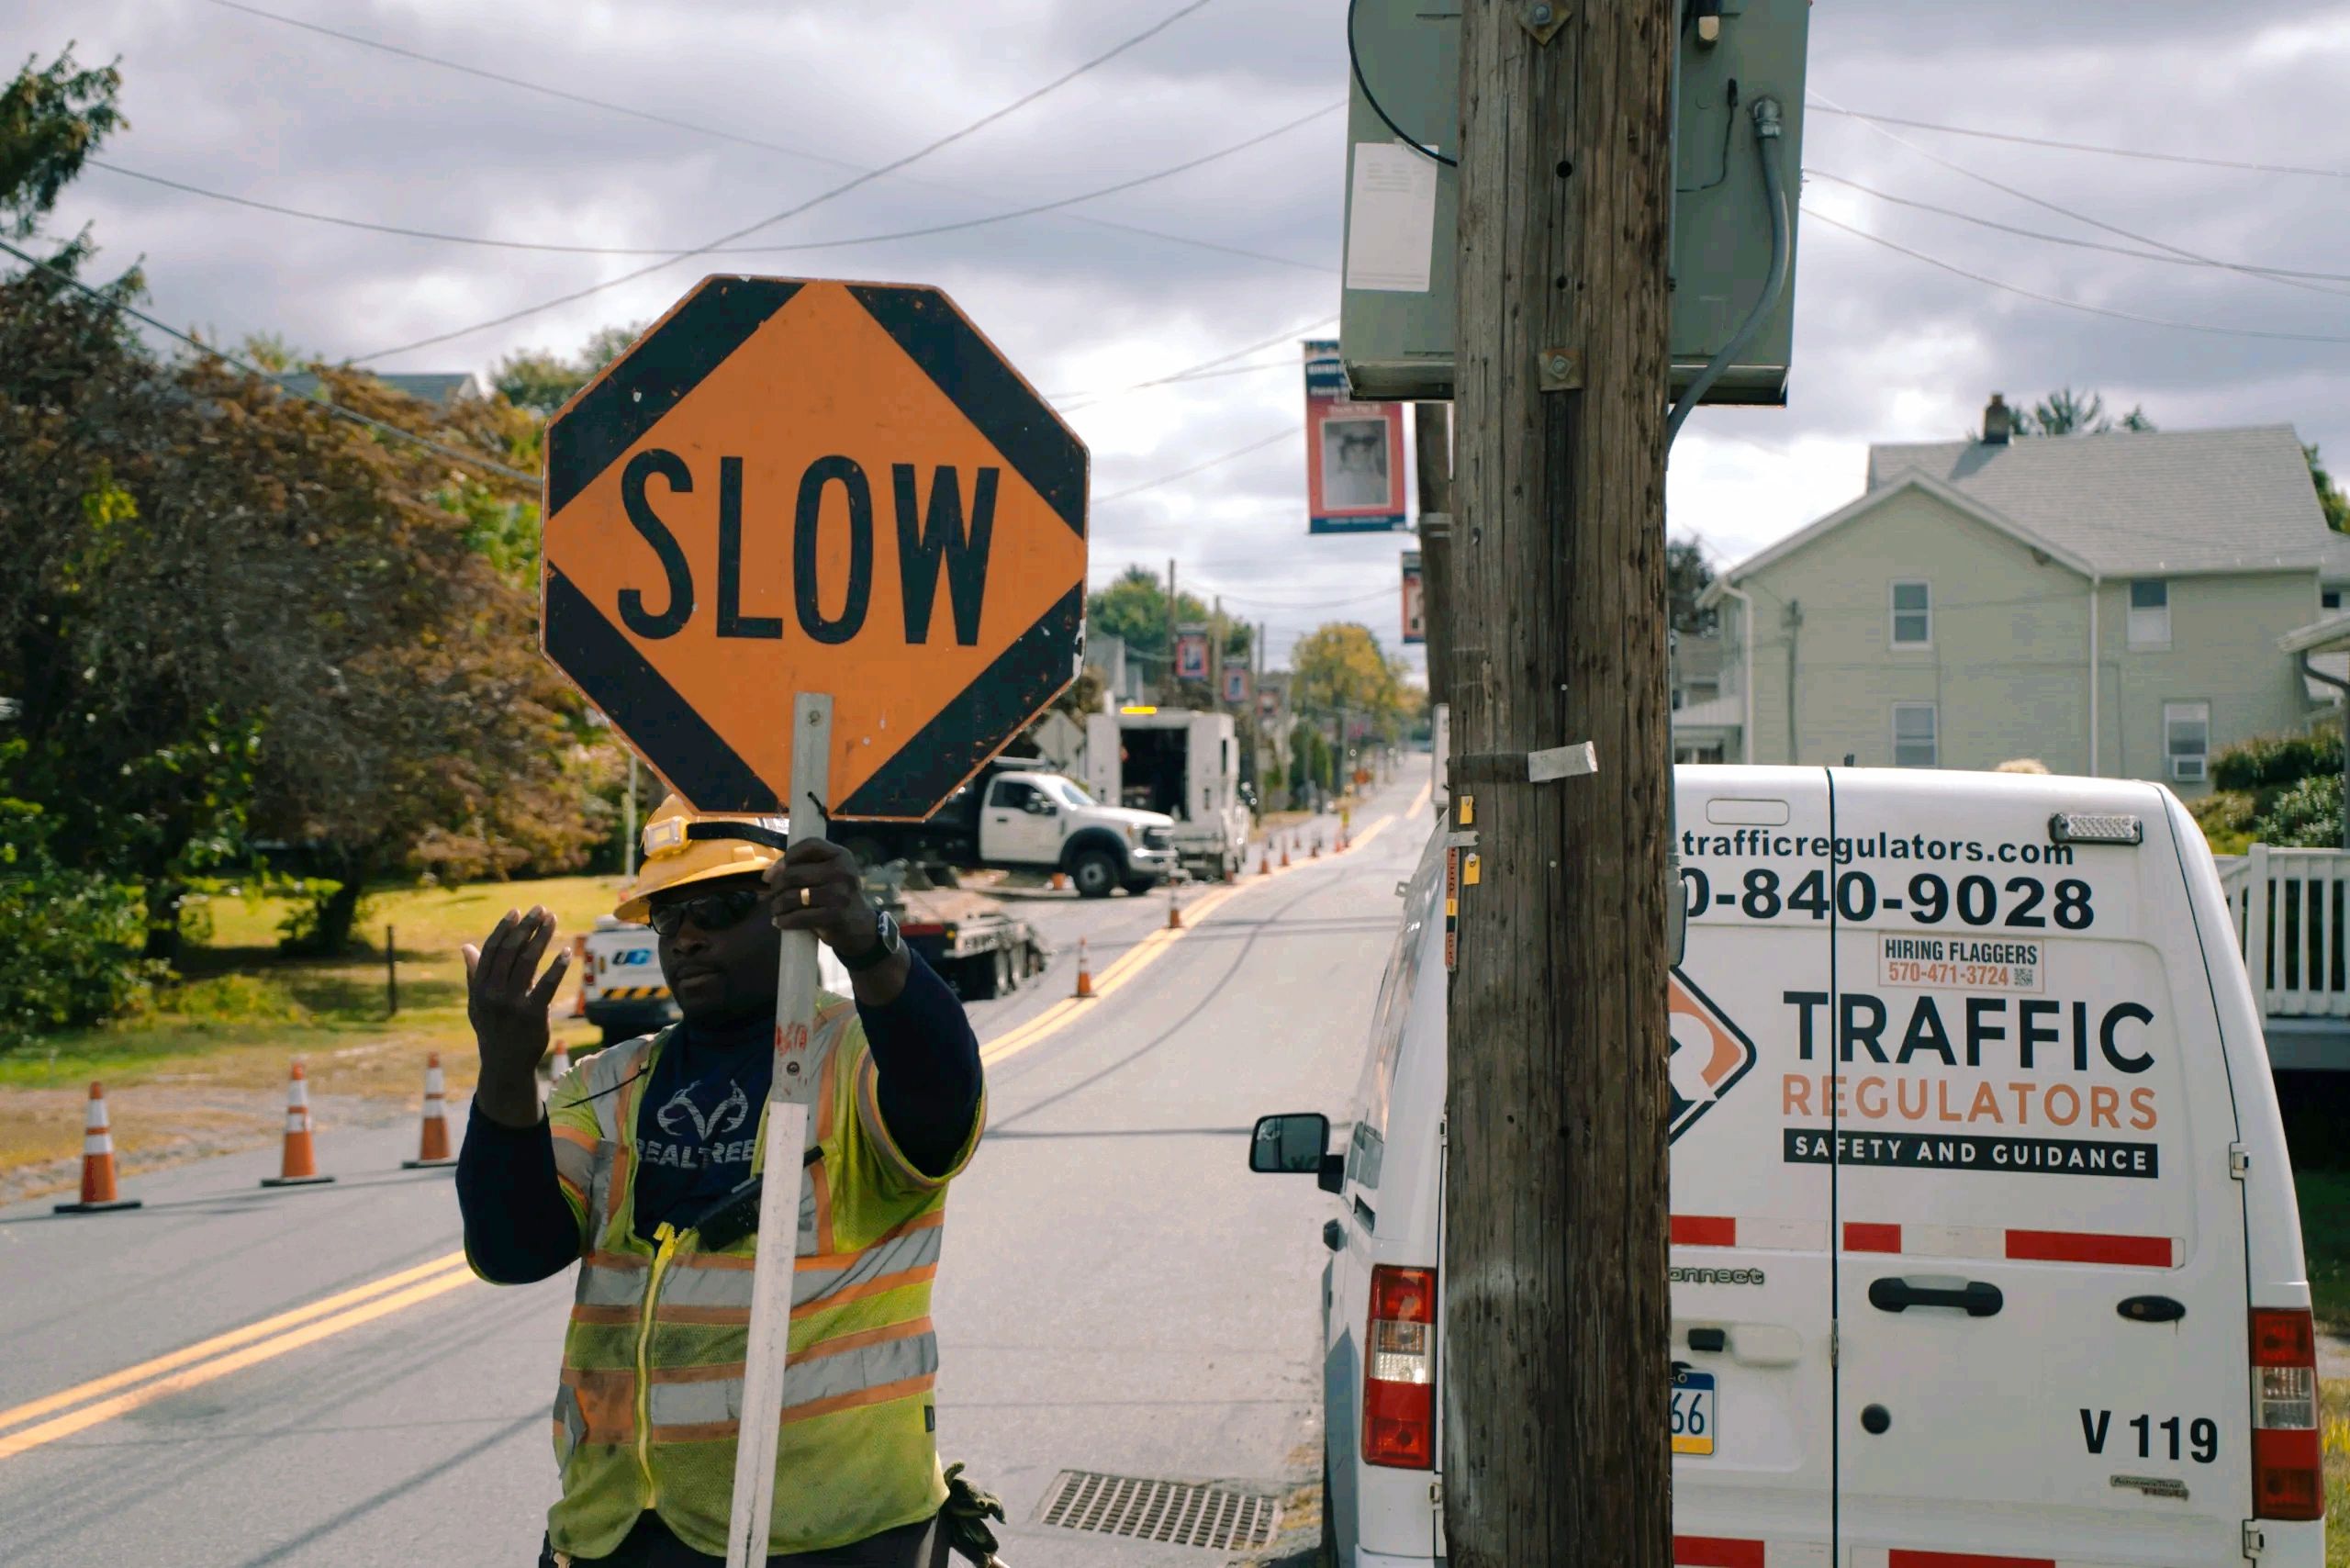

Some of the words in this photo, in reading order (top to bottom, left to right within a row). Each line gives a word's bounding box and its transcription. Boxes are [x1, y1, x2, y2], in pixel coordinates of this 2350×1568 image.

[618, 448, 1000, 646] SLOW
[1683, 830, 2074, 865] trafficregulators.com
[1681, 868, 2094, 930] 0-840-9028
[1886, 939, 1943, 961] HIRING
[1950, 942, 2038, 965] FLAGGERS
[1888, 961, 2009, 986] 570-471-3724
[1783, 991, 2155, 1074] TRAFFIC
[1783, 1074, 2157, 1131] REGULATORS
[1795, 1136, 1902, 1159] SAFETY
[1916, 1141, 1976, 1163] AND
[1992, 1144, 2147, 1171] GUIDANCE
[1670, 1267, 1764, 1284] onnect
[2079, 1408, 2111, 1454] V
[2129, 1414, 2218, 1463] 119
